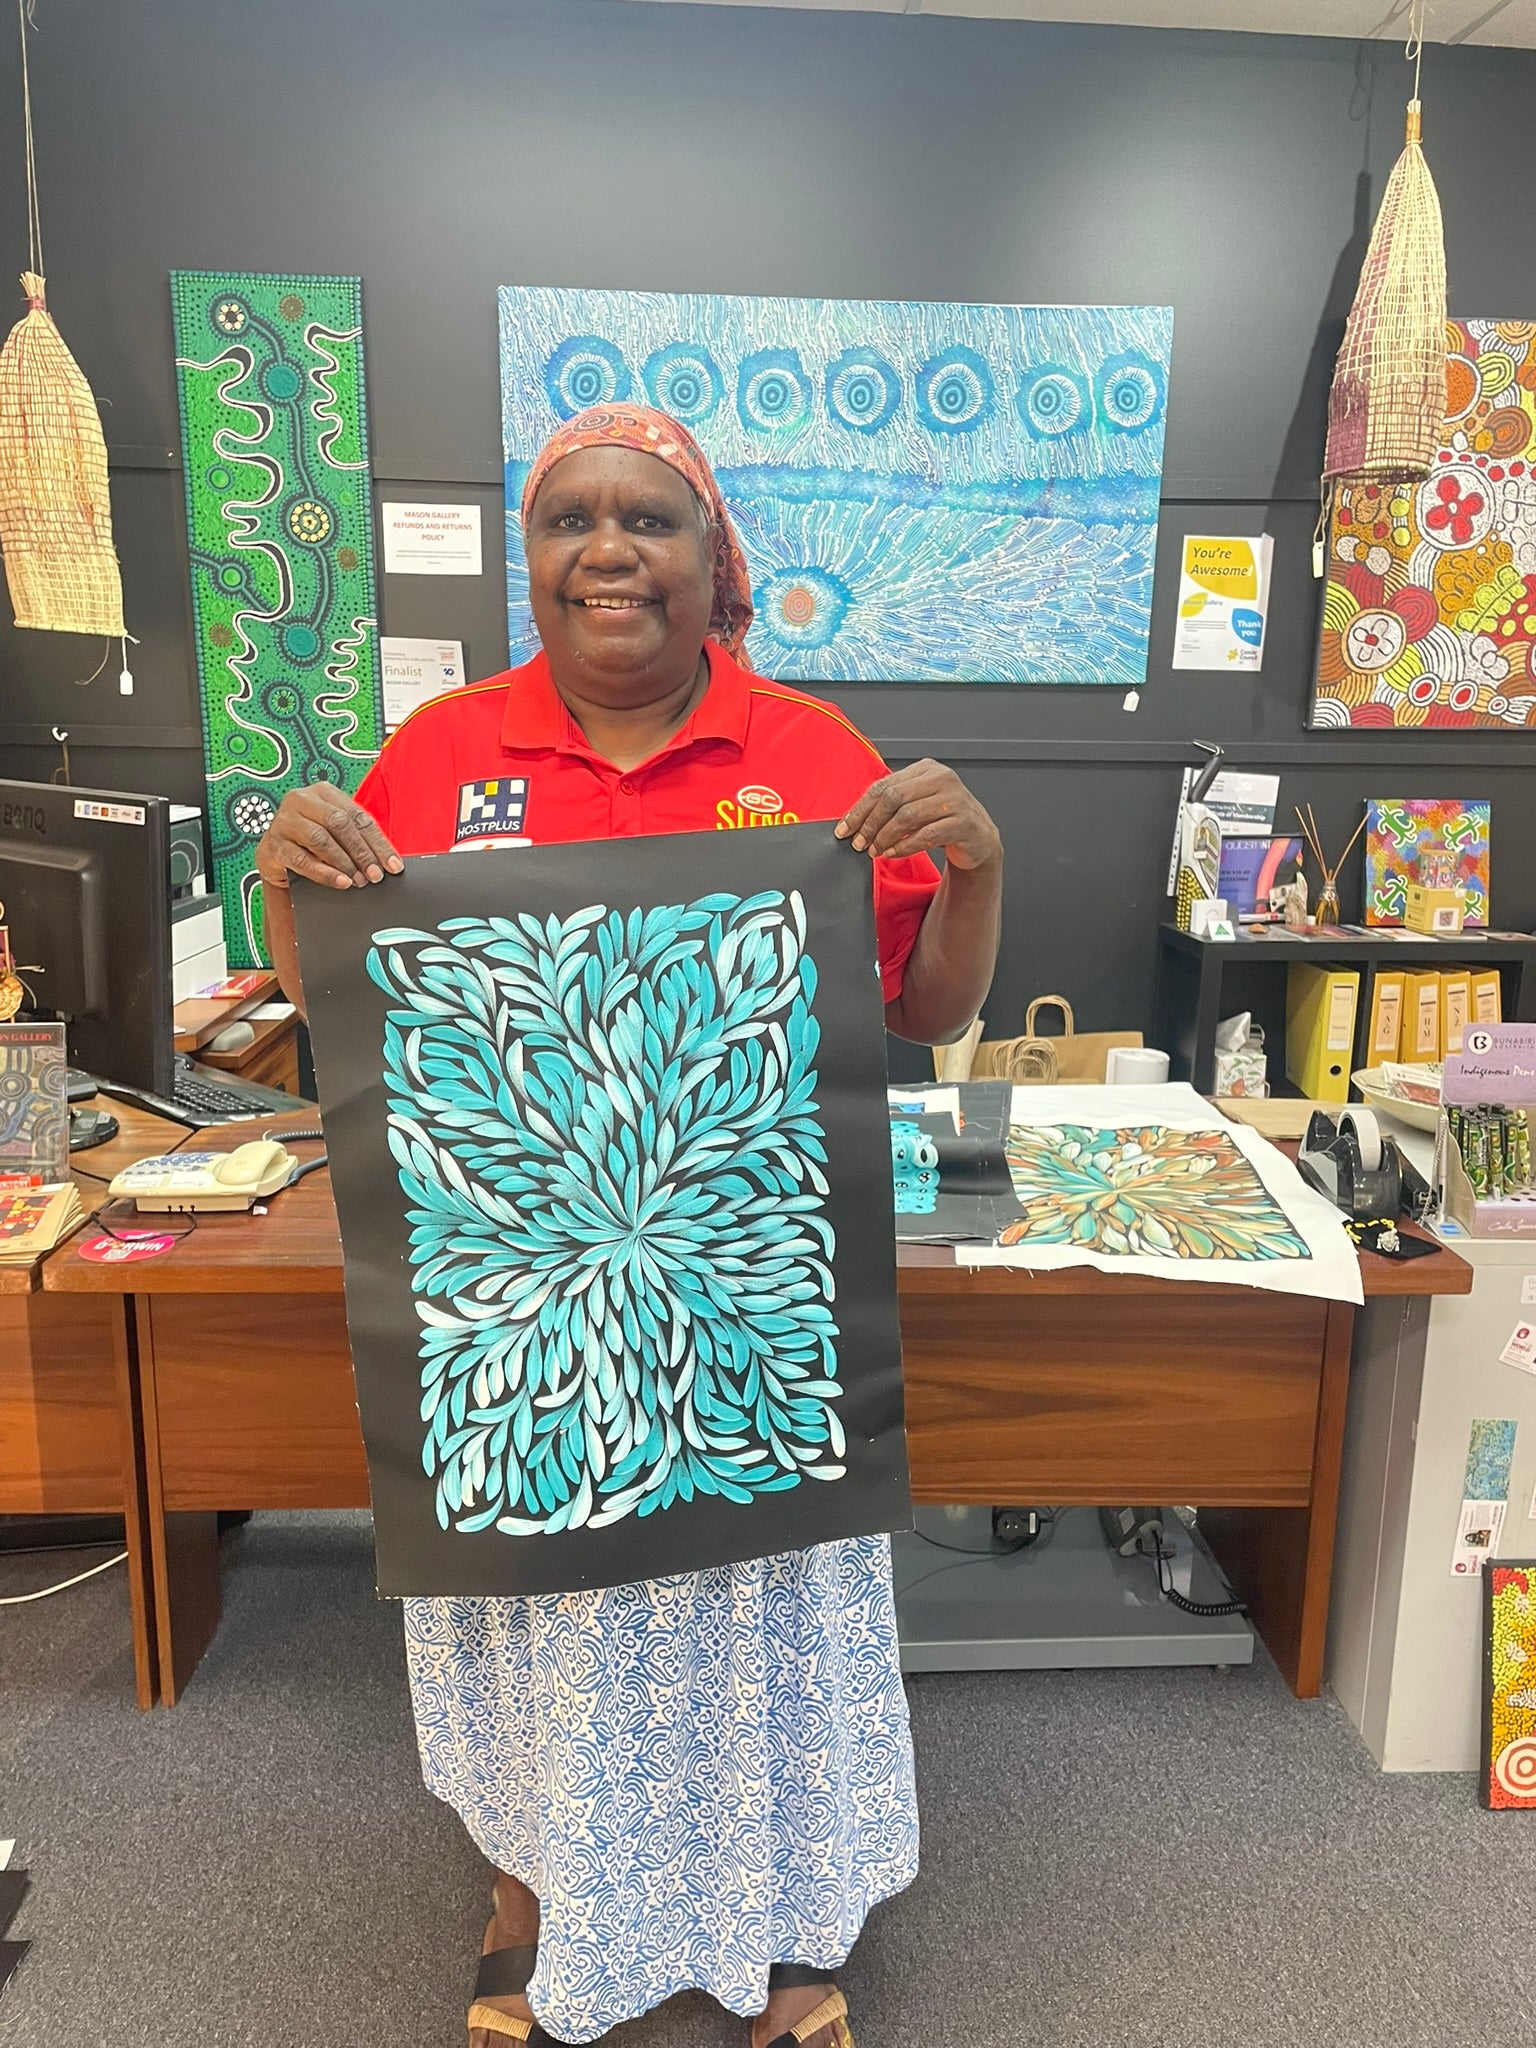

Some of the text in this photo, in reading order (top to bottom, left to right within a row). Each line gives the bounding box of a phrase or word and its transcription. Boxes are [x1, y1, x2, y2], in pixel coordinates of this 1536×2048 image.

[432, 511, 461, 519] GALLERY
[393, 522, 473, 531] REFUNDS AND RETURNS
[1193, 546, 1232, 559] You're
[1190, 563, 1254, 577] Awesome!
[1236, 619, 1262, 629] Thank
[1241, 630, 1257, 638] you
[384, 664, 423, 677] Finalist
[457, 820, 520, 839] HOSTPLUS
[10, 1032, 53, 1041] GALLERY
[1460, 1064, 1511, 1079] Indigenous
